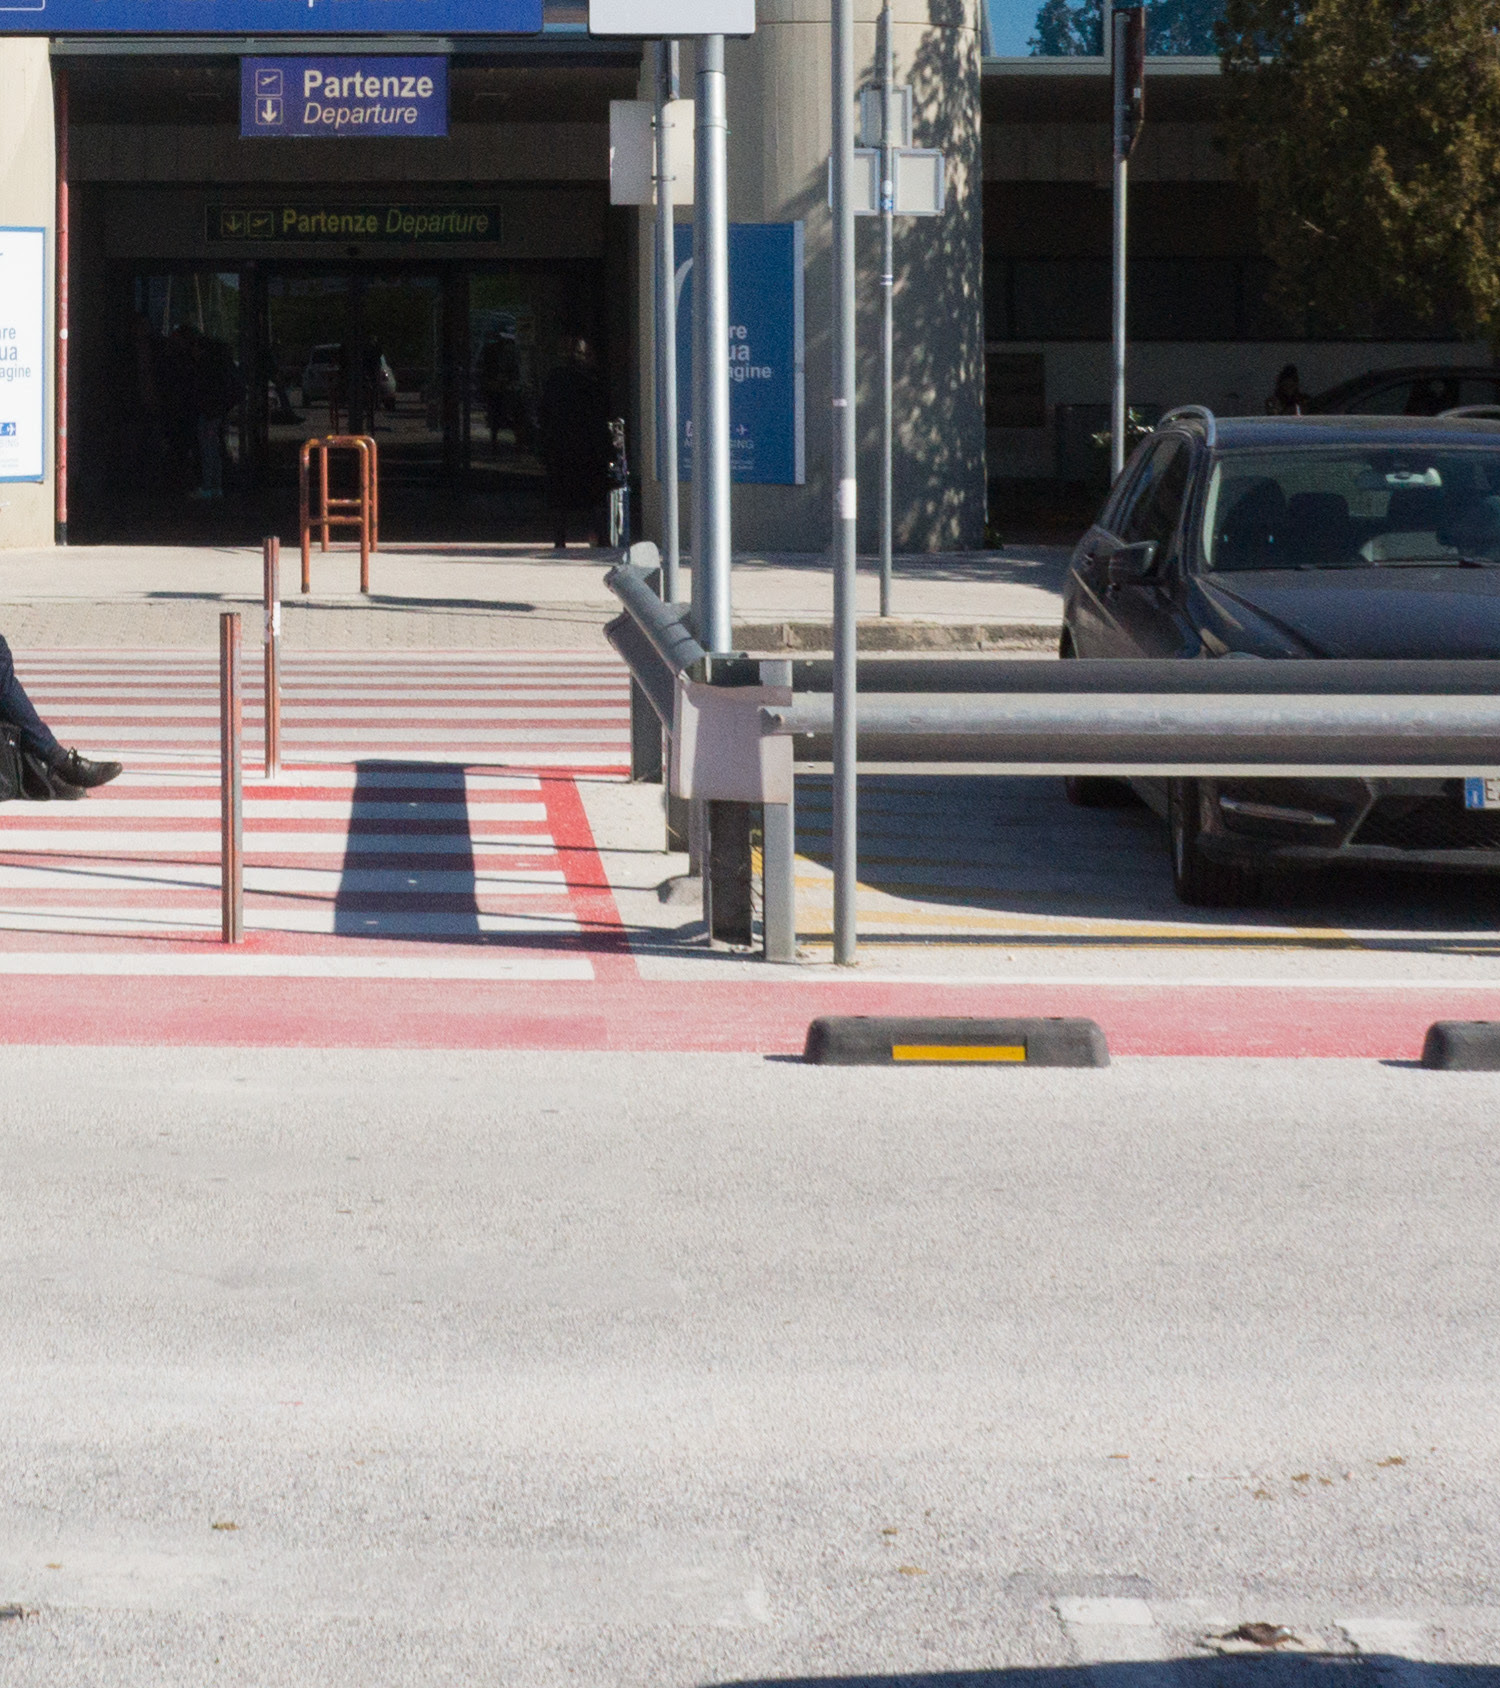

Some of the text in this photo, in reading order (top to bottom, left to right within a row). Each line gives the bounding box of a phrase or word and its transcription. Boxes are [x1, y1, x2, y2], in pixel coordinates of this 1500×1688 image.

[303, 69, 434, 99] Partenze
[303, 101, 418, 130] Departure
[282, 208, 490, 239] Partenze Departure
